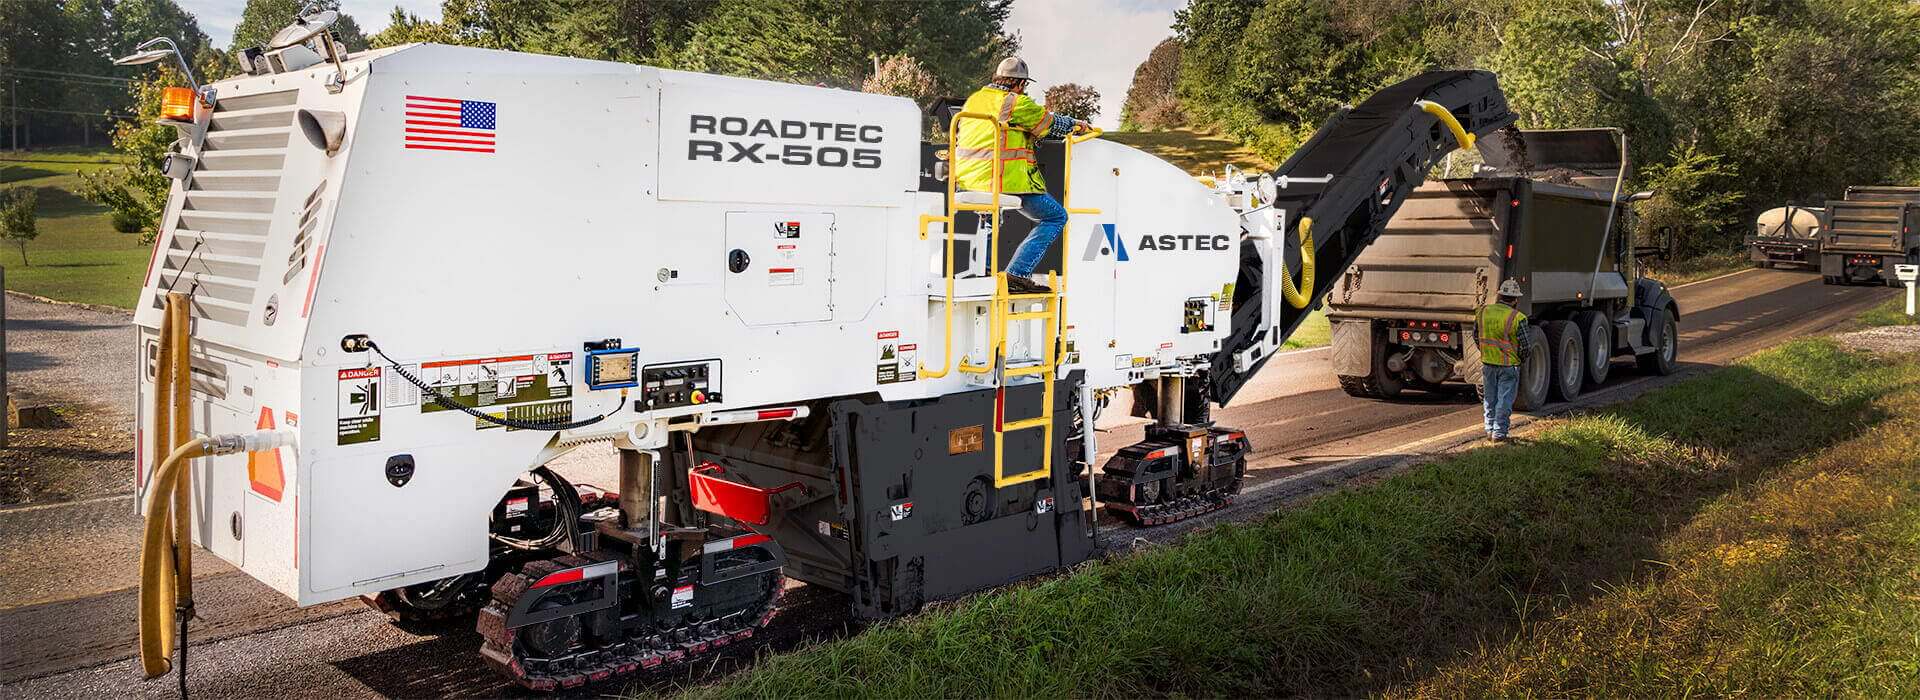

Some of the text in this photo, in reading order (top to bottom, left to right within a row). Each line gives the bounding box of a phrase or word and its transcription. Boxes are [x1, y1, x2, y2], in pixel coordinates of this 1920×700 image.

[690, 114, 883, 143] ROADTEC
[687, 139, 882, 169] RX-505
[1138, 234, 1230, 251] ASTEC
[348, 369, 379, 378] DANGER
